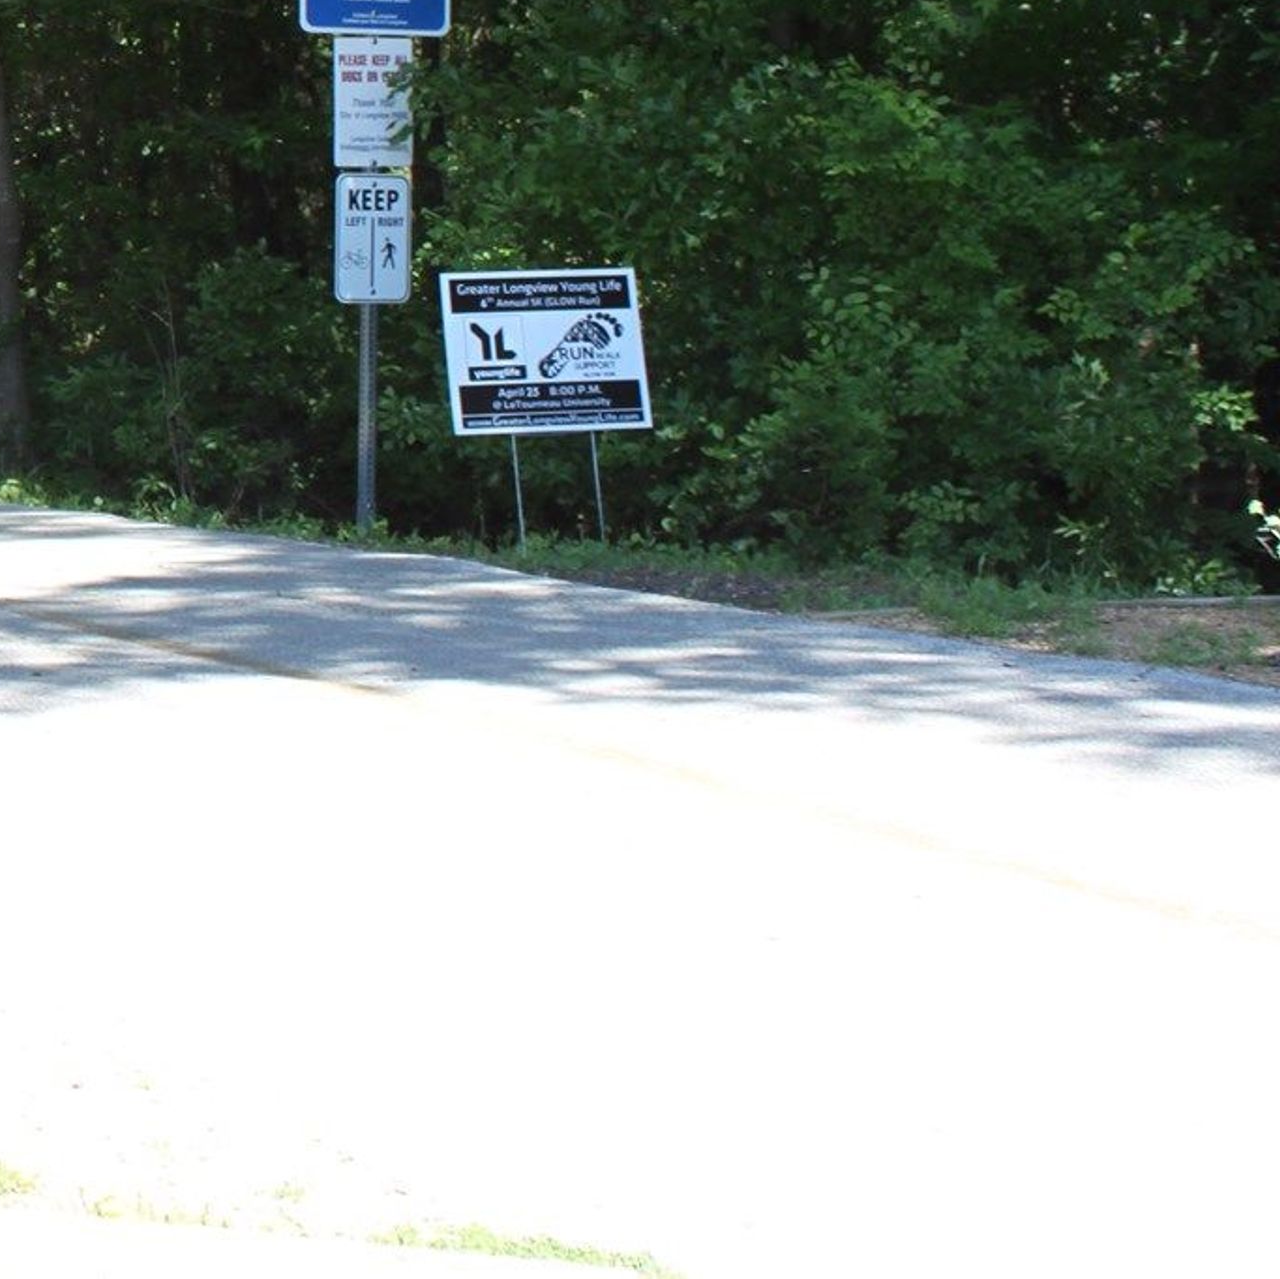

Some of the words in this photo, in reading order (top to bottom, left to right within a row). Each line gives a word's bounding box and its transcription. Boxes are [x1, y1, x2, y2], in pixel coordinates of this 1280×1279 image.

[372, 54, 390, 66] KEEP
[348, 189, 399, 211] KEEP
[345, 216, 366, 227] LEFT
[378, 216, 404, 227] RIGHT
[456, 283, 500, 297] Greater
[502, 281, 558, 297] Longview
[559, 281, 598, 295] Young
[599, 278, 622, 292] Life
[559, 347, 595, 360] RUN
[497, 386, 525, 399] April
